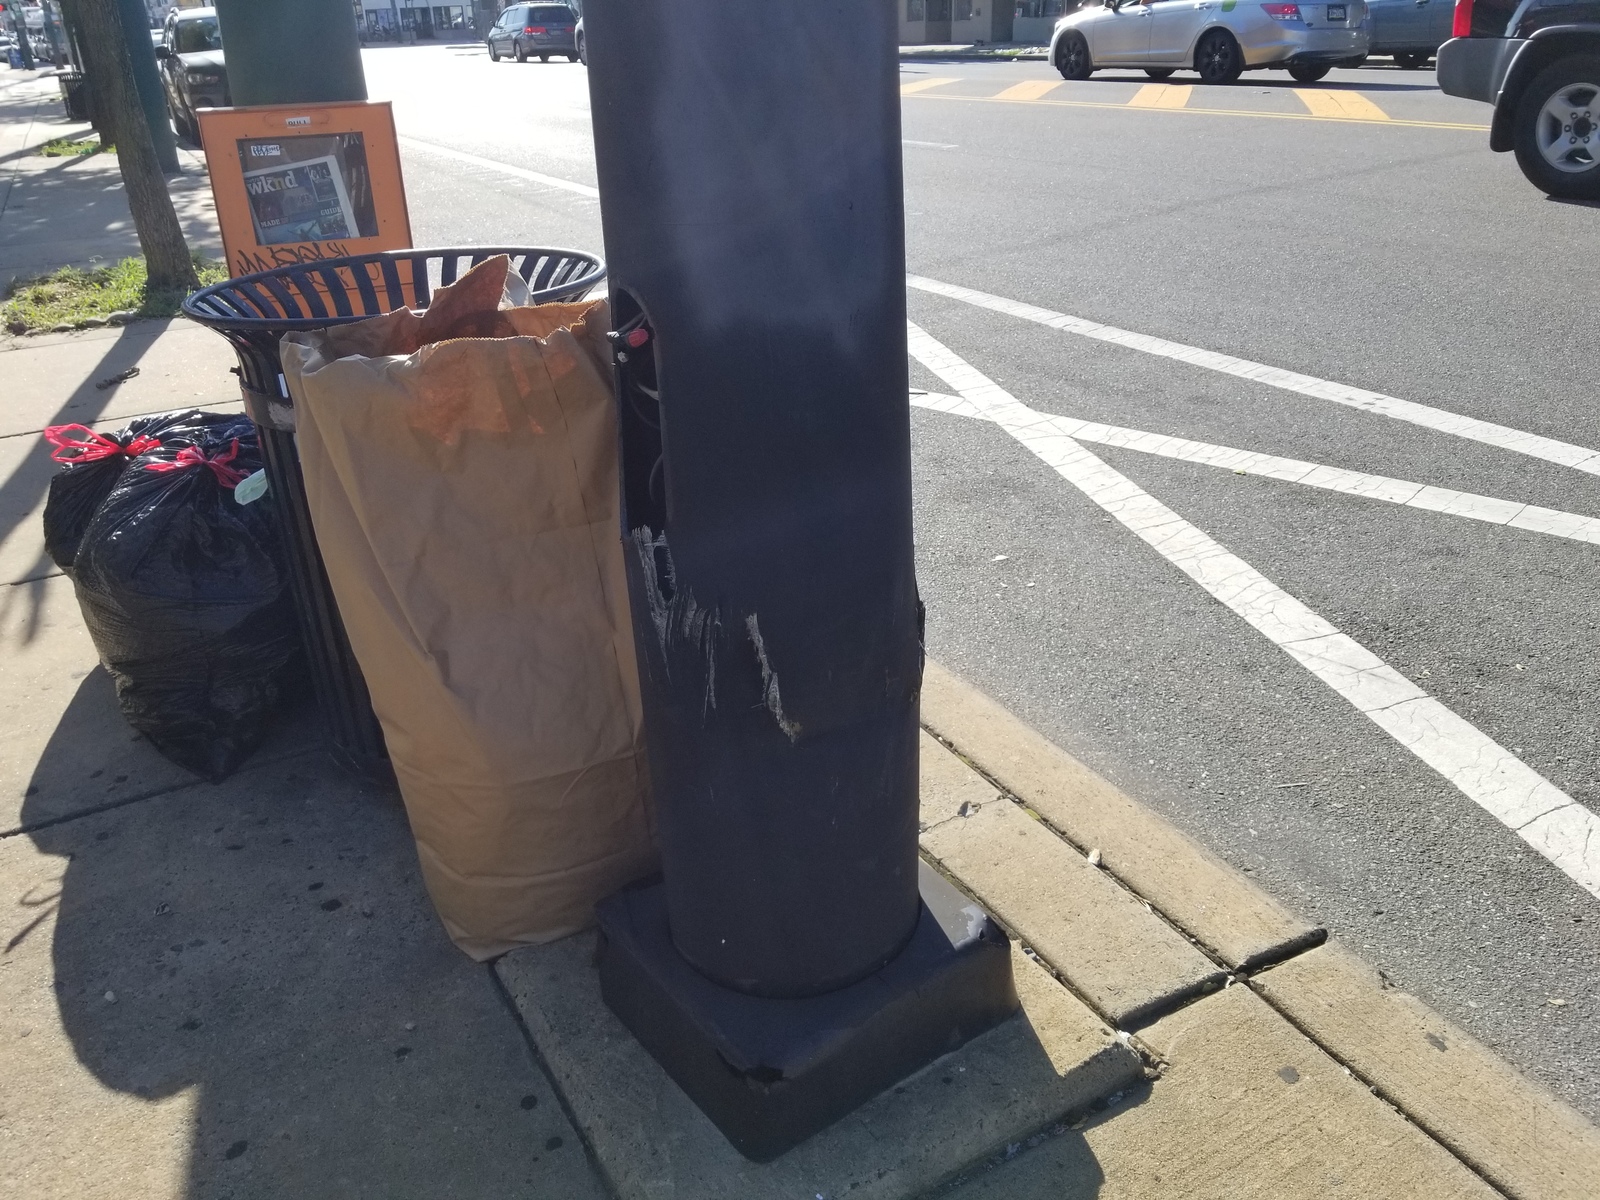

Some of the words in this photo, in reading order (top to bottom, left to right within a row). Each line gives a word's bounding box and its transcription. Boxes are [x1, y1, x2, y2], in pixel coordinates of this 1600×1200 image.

[246, 171, 298, 195] wknd
[320, 207, 342, 216] GUIDE
[260, 218, 281, 228] MADE
